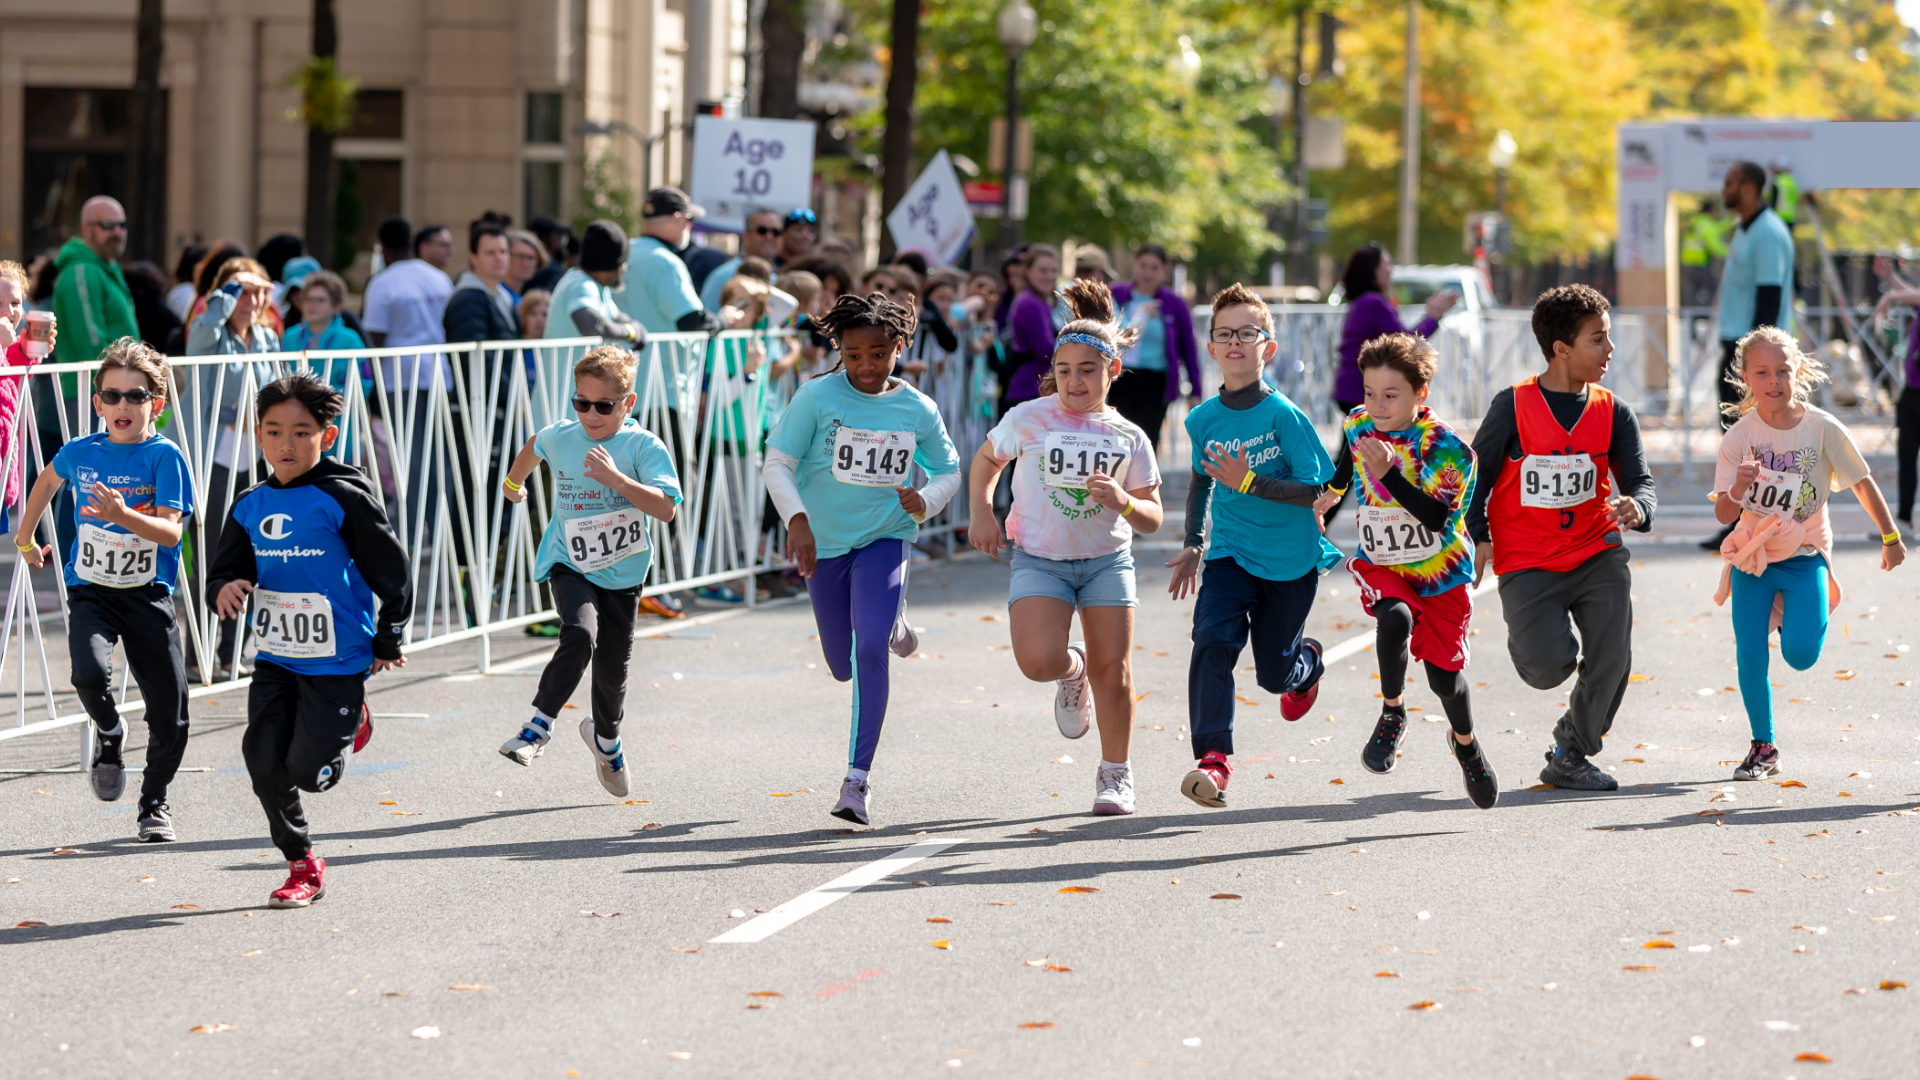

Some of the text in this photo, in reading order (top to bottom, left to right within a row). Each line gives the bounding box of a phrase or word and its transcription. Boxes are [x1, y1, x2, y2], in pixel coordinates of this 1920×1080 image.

[723, 130, 785, 167] Age
[731, 169, 772, 196] 10
[1266, 430, 1276, 441] FO
[838, 444, 909, 475] 9-143
[1049, 447, 1126, 478] 9-167
[108, 476, 130, 484] race
[1526, 468, 1594, 497] 9-130
[558, 490, 601, 503] every child
[1048, 490, 1081, 521] קפיטל
[1749, 481, 1793, 512] 104
[93, 531, 107, 539] race
[598, 520, 613, 529] child
[1363, 523, 1434, 552] 9-120
[92, 536, 109, 547] every
[571, 520, 641, 562] 9-128
[81, 541, 153, 577] 9-125
[280, 602, 295, 610] child
[256, 607, 328, 644] 9-109
